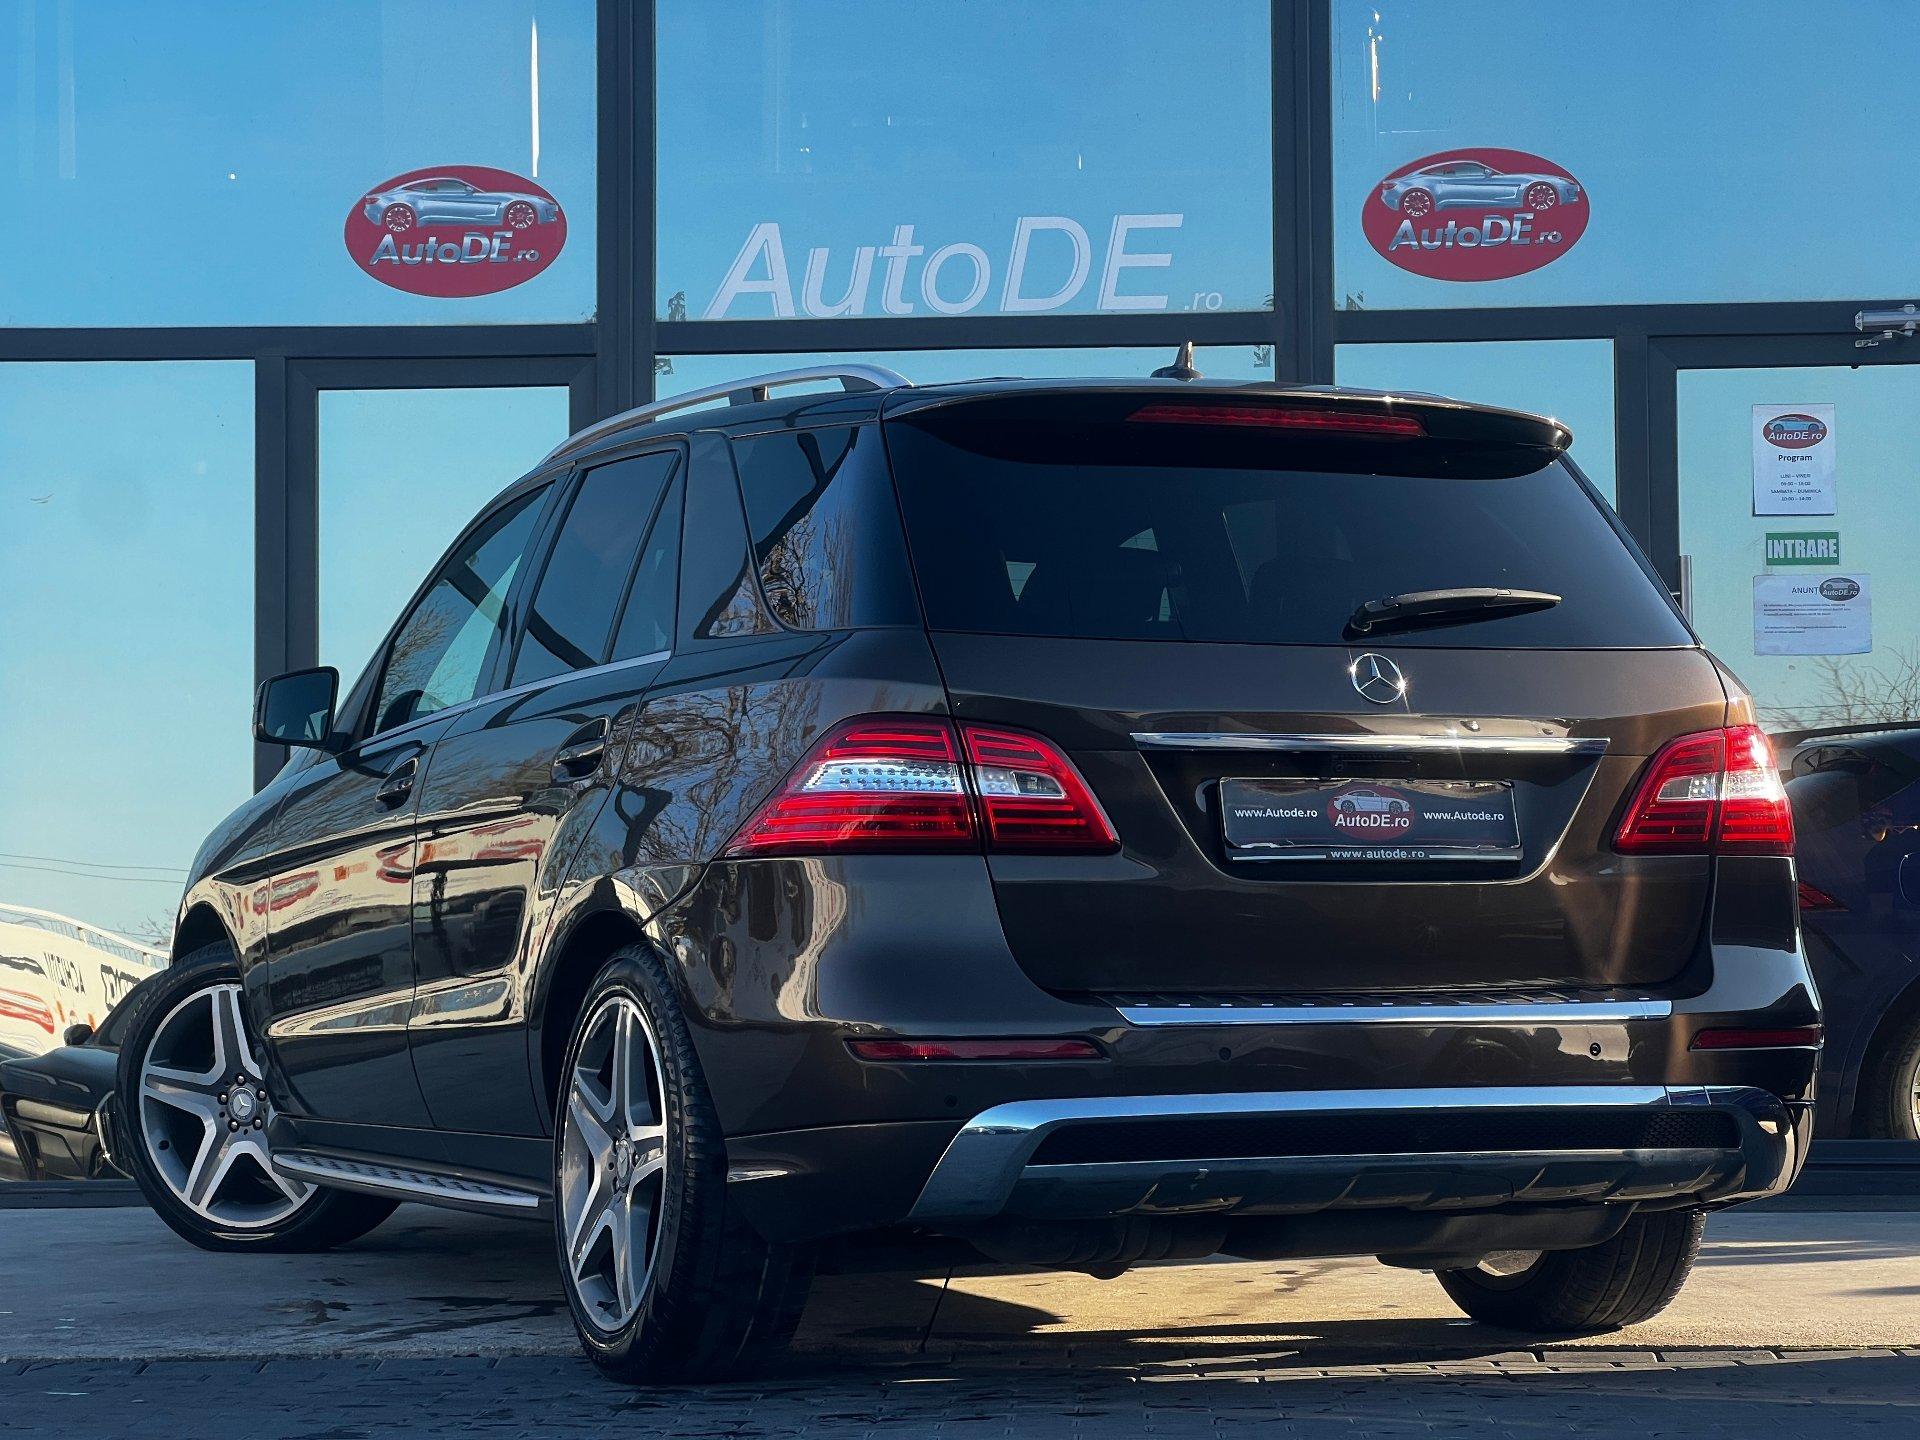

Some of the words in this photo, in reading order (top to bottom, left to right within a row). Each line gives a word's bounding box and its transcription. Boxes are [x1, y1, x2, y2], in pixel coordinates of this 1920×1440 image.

[1388, 212, 1563, 251] AutoDE.ro
[369, 230, 540, 265] AutoDE.ro
[1768, 431, 1823, 440] AutoDE.ro
[1778, 454, 1813, 463] Program
[1767, 538, 1837, 559] INTRARE
[1234, 806, 1319, 819] www.Autode.ro
[1334, 812, 1410, 828] AutoDE.ro
[1423, 810, 1505, 822] www.Autode.ro
[1330, 848, 1425, 860] www.autode.ro
